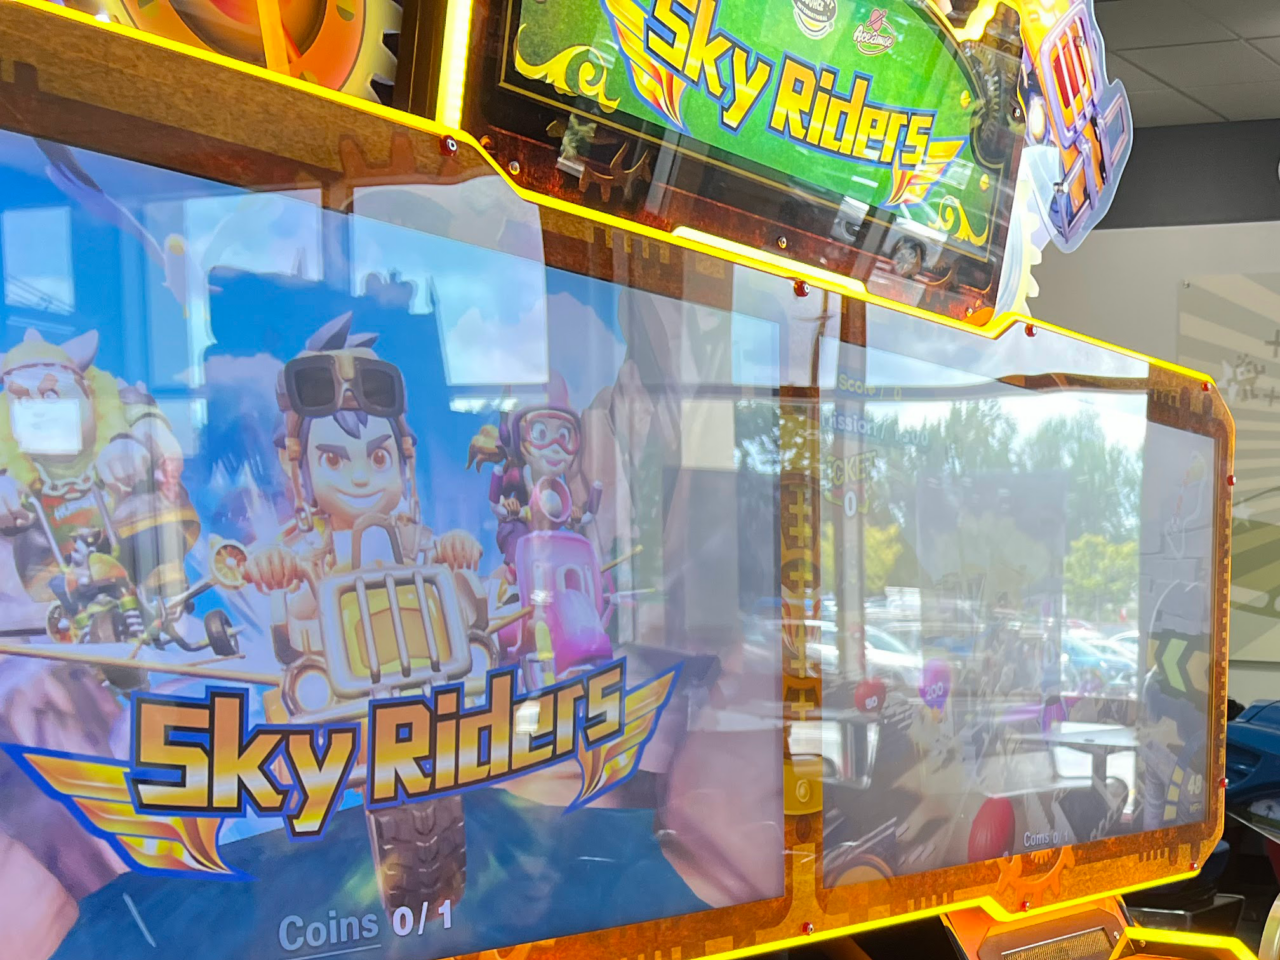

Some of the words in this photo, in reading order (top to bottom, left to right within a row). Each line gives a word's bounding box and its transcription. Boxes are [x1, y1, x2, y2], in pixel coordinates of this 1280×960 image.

[646, 0, 771, 128] Sky
[767, 57, 933, 169] Riders
[844, 491, 857, 517] 0
[925, 681, 944, 700] 200
[134, 691, 357, 836] Sky
[369, 662, 625, 804] Riders
[1023, 831, 1050, 847] Coins
[279, 910, 379, 952] Coins
